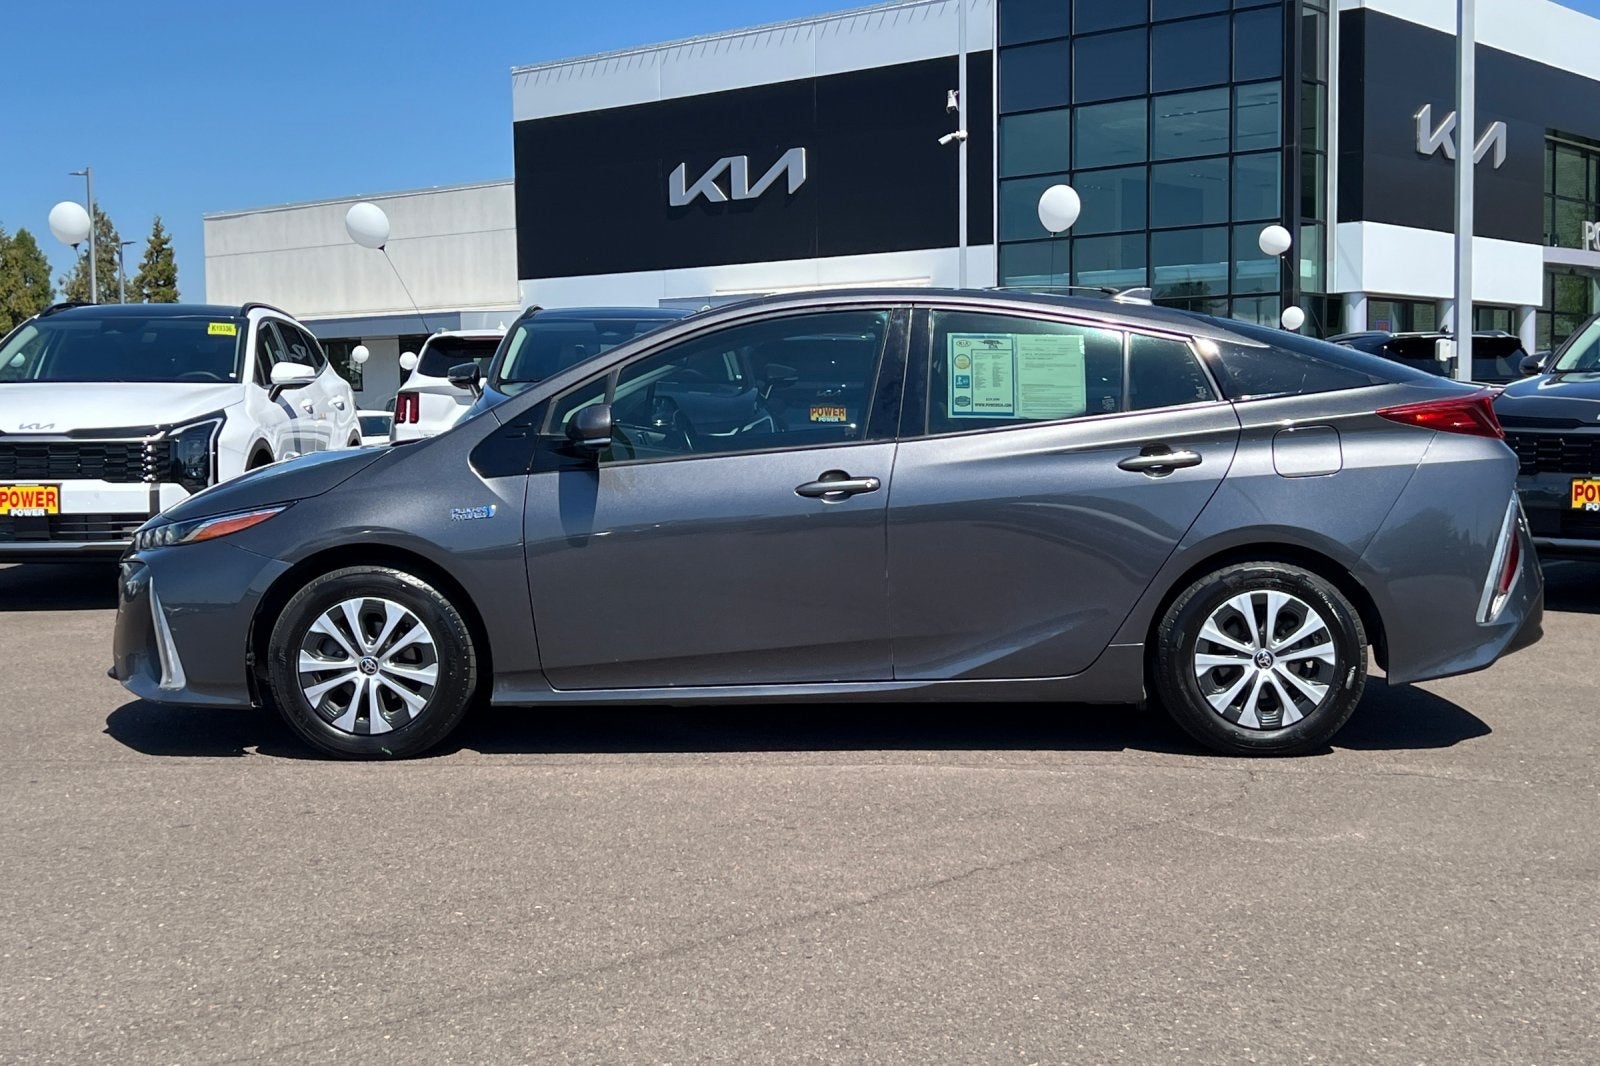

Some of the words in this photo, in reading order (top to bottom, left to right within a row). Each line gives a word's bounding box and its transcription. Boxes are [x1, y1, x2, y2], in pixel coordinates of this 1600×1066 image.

[669, 147, 806, 207] KIA
[811, 407, 845, 417] POWER
[0, 491, 56, 507] POWER
[1574, 484, 1600, 502] PO
[10, 508, 45, 517] POWER
